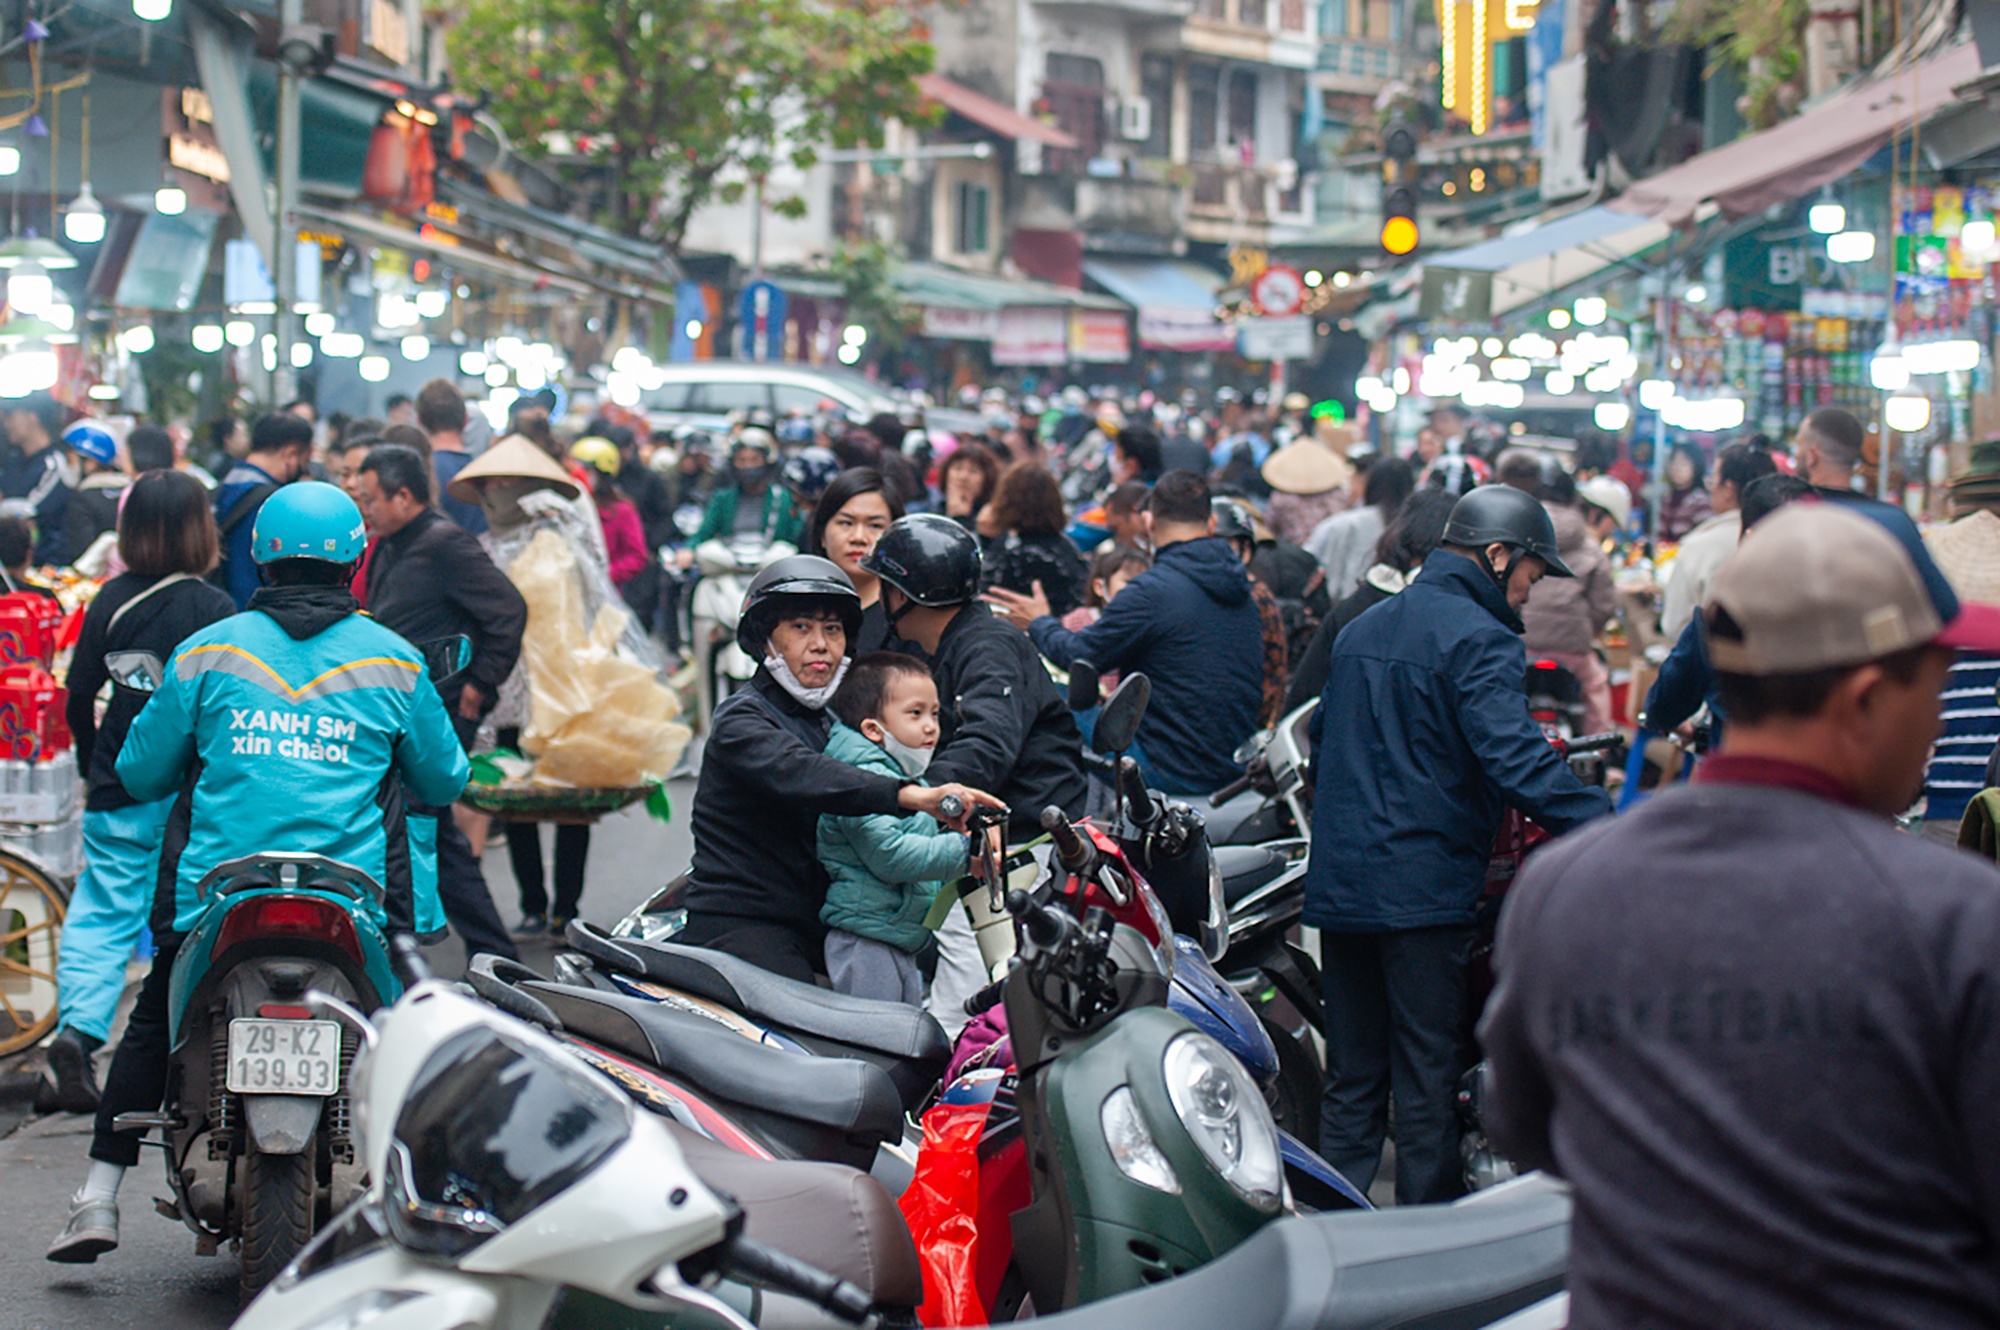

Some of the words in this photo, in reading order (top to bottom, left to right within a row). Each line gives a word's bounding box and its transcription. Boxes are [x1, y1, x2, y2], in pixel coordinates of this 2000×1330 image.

[229, 709, 311, 735] XANH
[316, 716, 357, 741] SM
[231, 732, 271, 755] xin
[278, 736, 350, 763] chào!
[246, 1025, 321, 1056] 29-K2
[238, 1058, 329, 1089] 139.93
